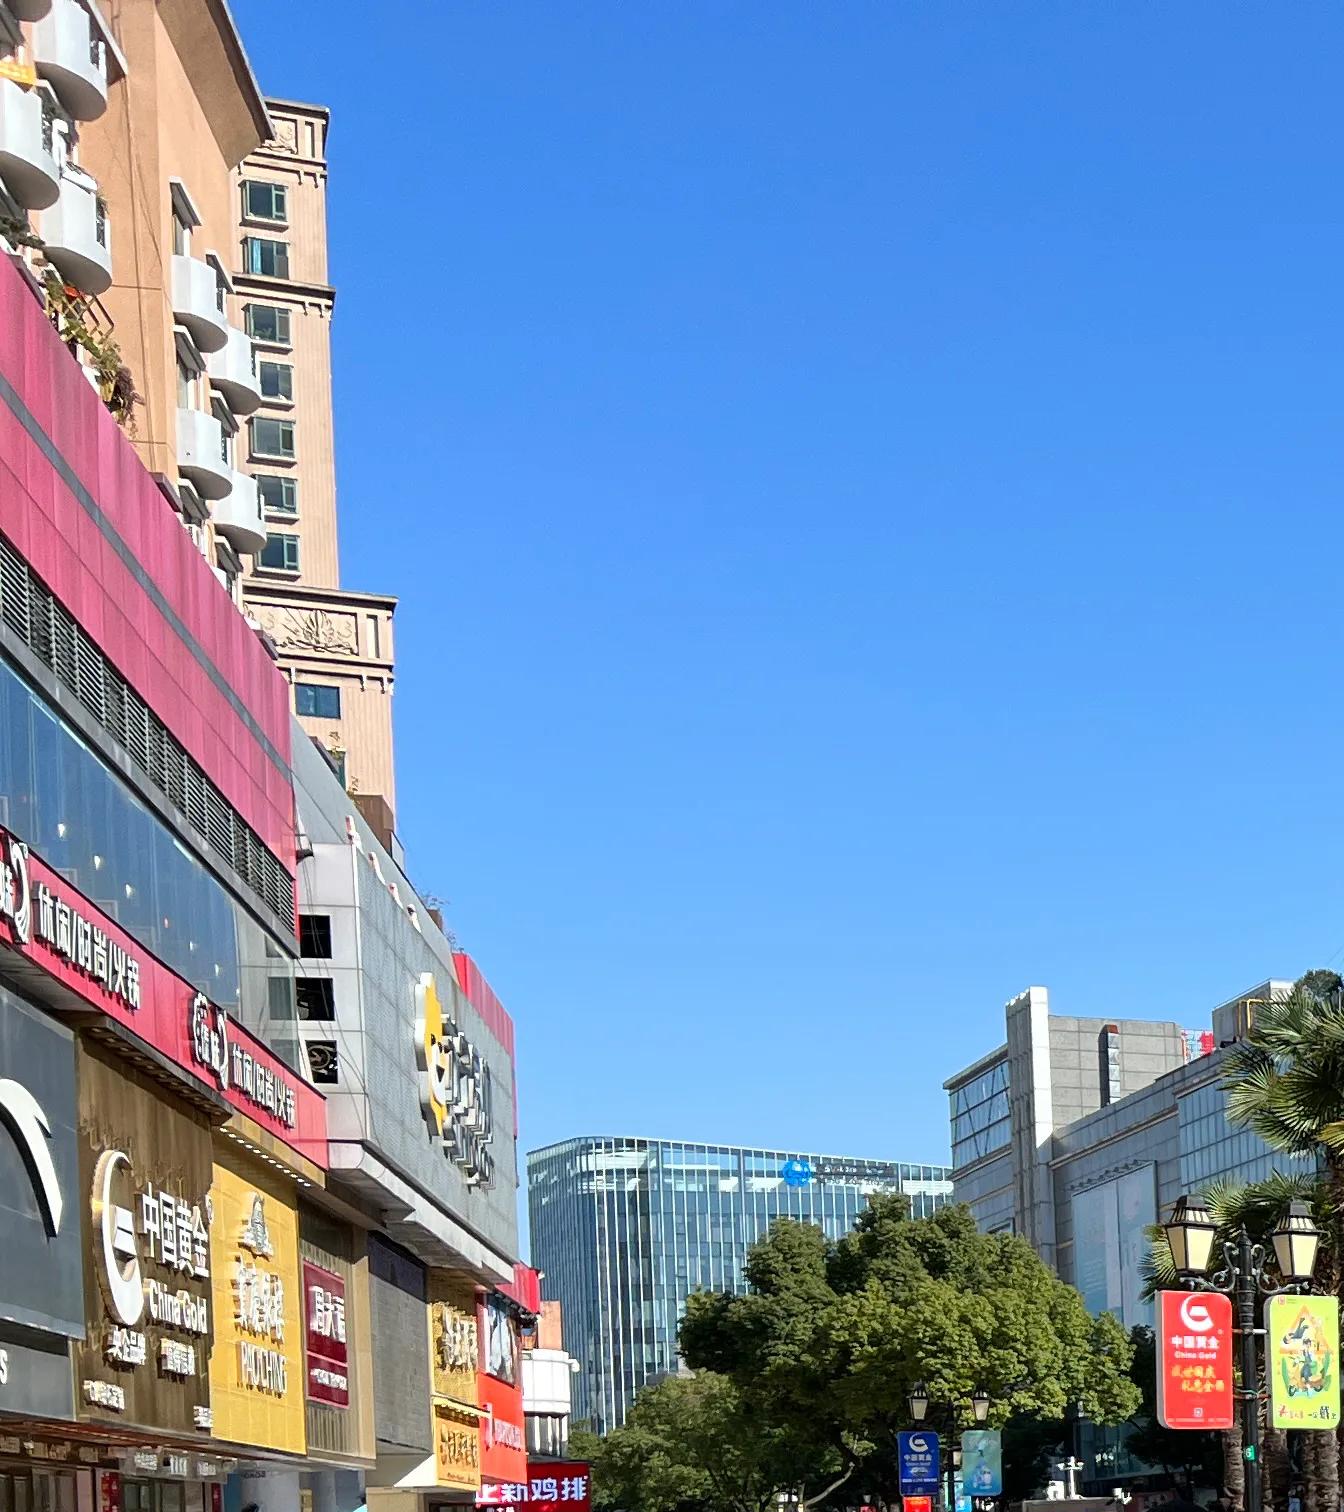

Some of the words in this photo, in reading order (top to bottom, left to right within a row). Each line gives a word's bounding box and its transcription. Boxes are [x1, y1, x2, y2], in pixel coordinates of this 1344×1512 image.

[141, 1182, 209, 1278] 中国黄金
[149, 1278, 186, 1325] China
[183, 1292, 209, 1335] Gold
[1171, 1335, 1220, 1349] 中国黄金
